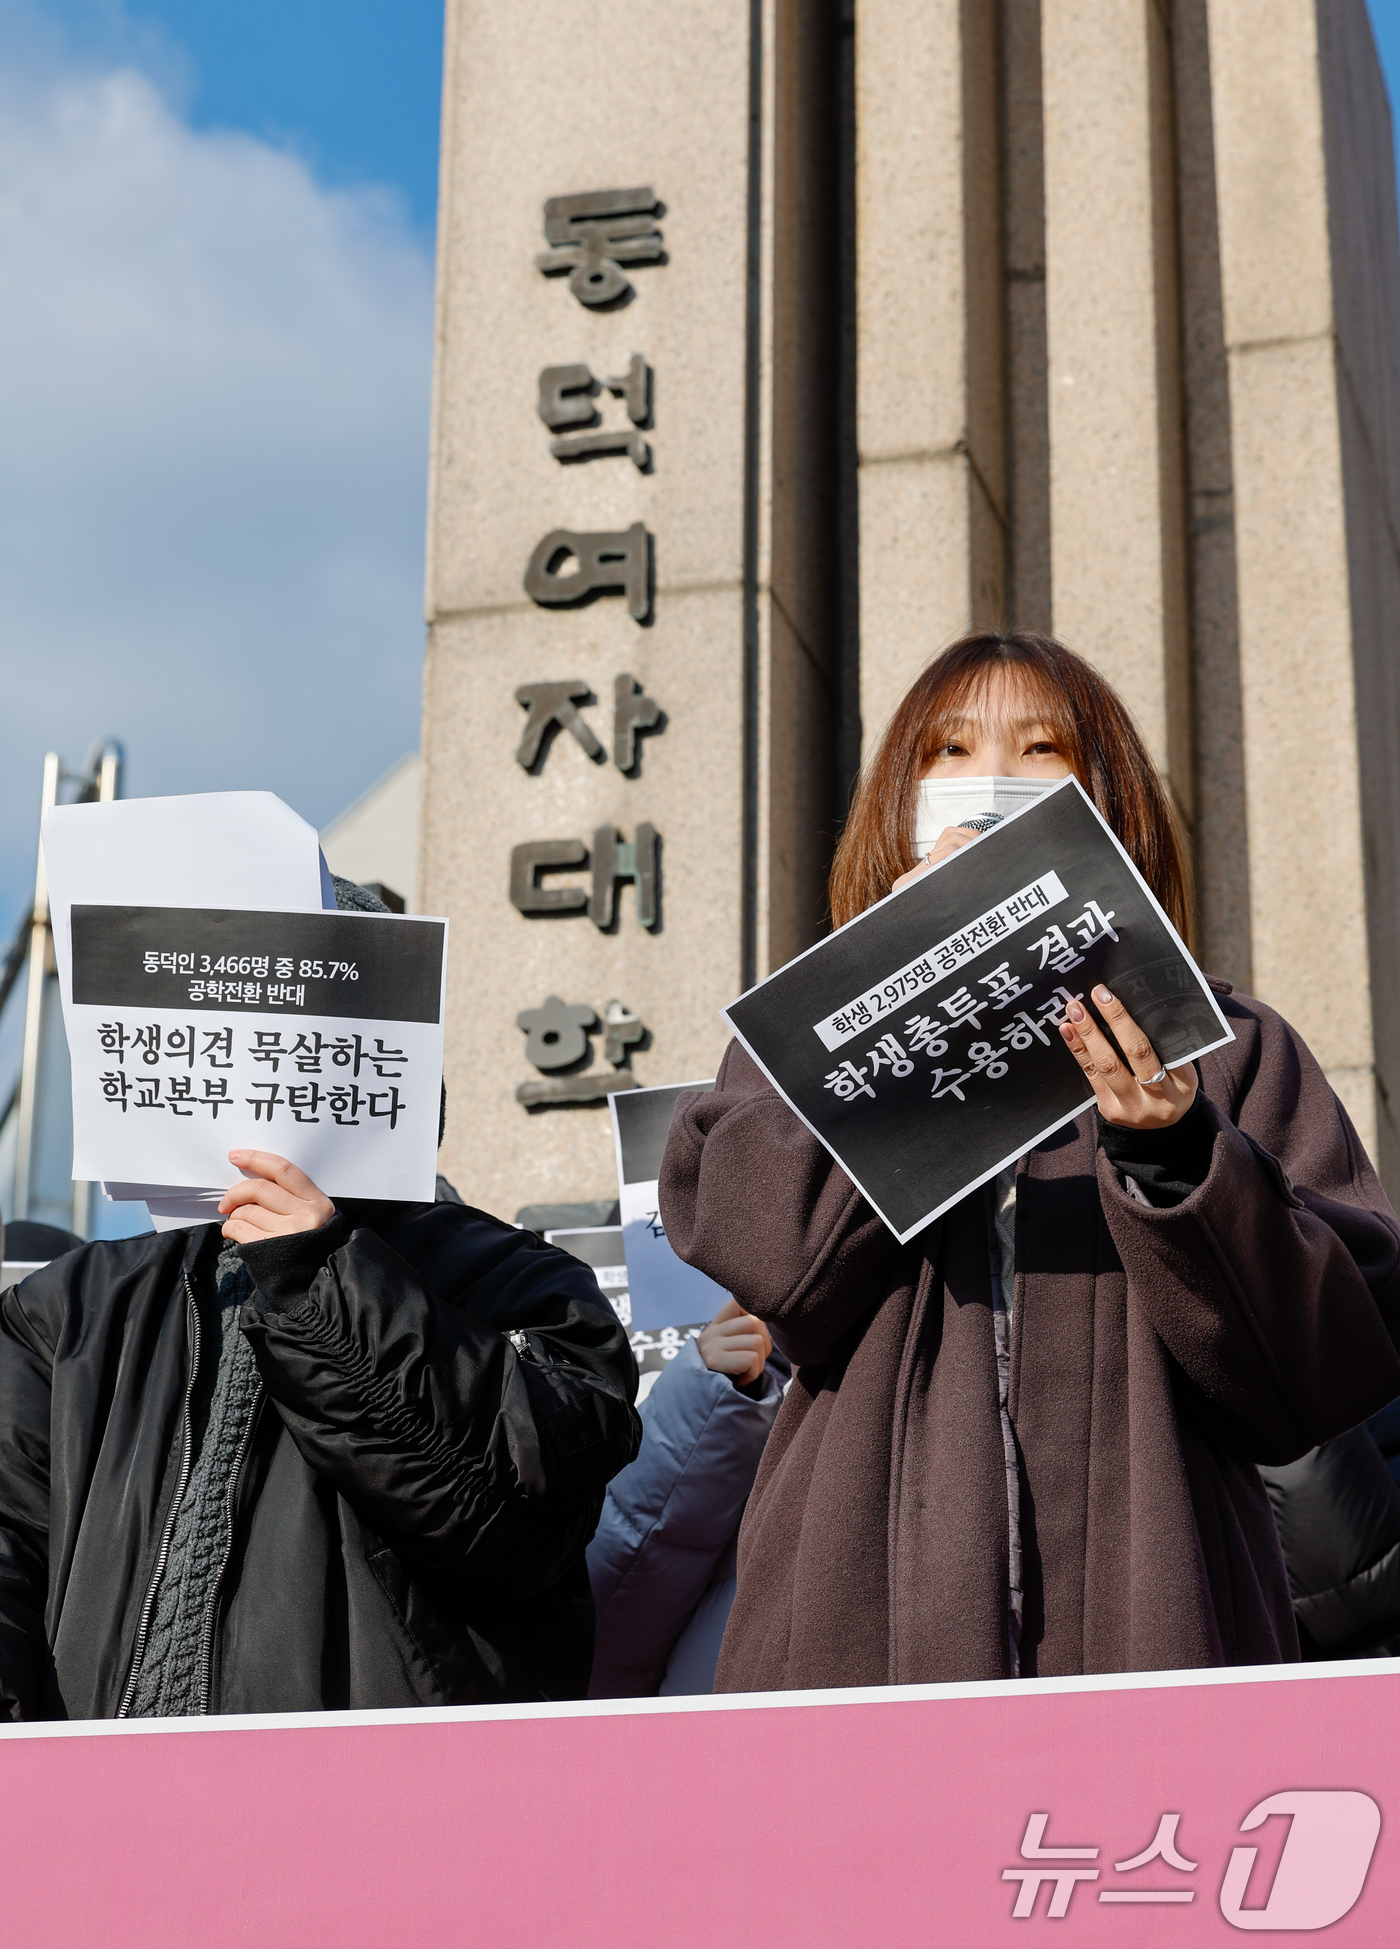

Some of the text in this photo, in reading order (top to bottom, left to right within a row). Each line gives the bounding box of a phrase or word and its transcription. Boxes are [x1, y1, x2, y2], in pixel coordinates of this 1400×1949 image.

[509, 186, 664, 1232] 동덕여자대학
[142, 951, 360, 981] 동덕인 3,466명 중 85.7%
[187, 979, 306, 1007] 공학전환 반대
[823, 899, 1122, 1103] 학생총투표 결과
[831, 884, 1051, 1037] 학생 2,975명 공학전환 반대
[97, 1022, 409, 1078] 학생의견 묵살하는
[930, 984, 1085, 1102] 수용하라
[99, 1071, 406, 1130] 학교본부 규탄한다
